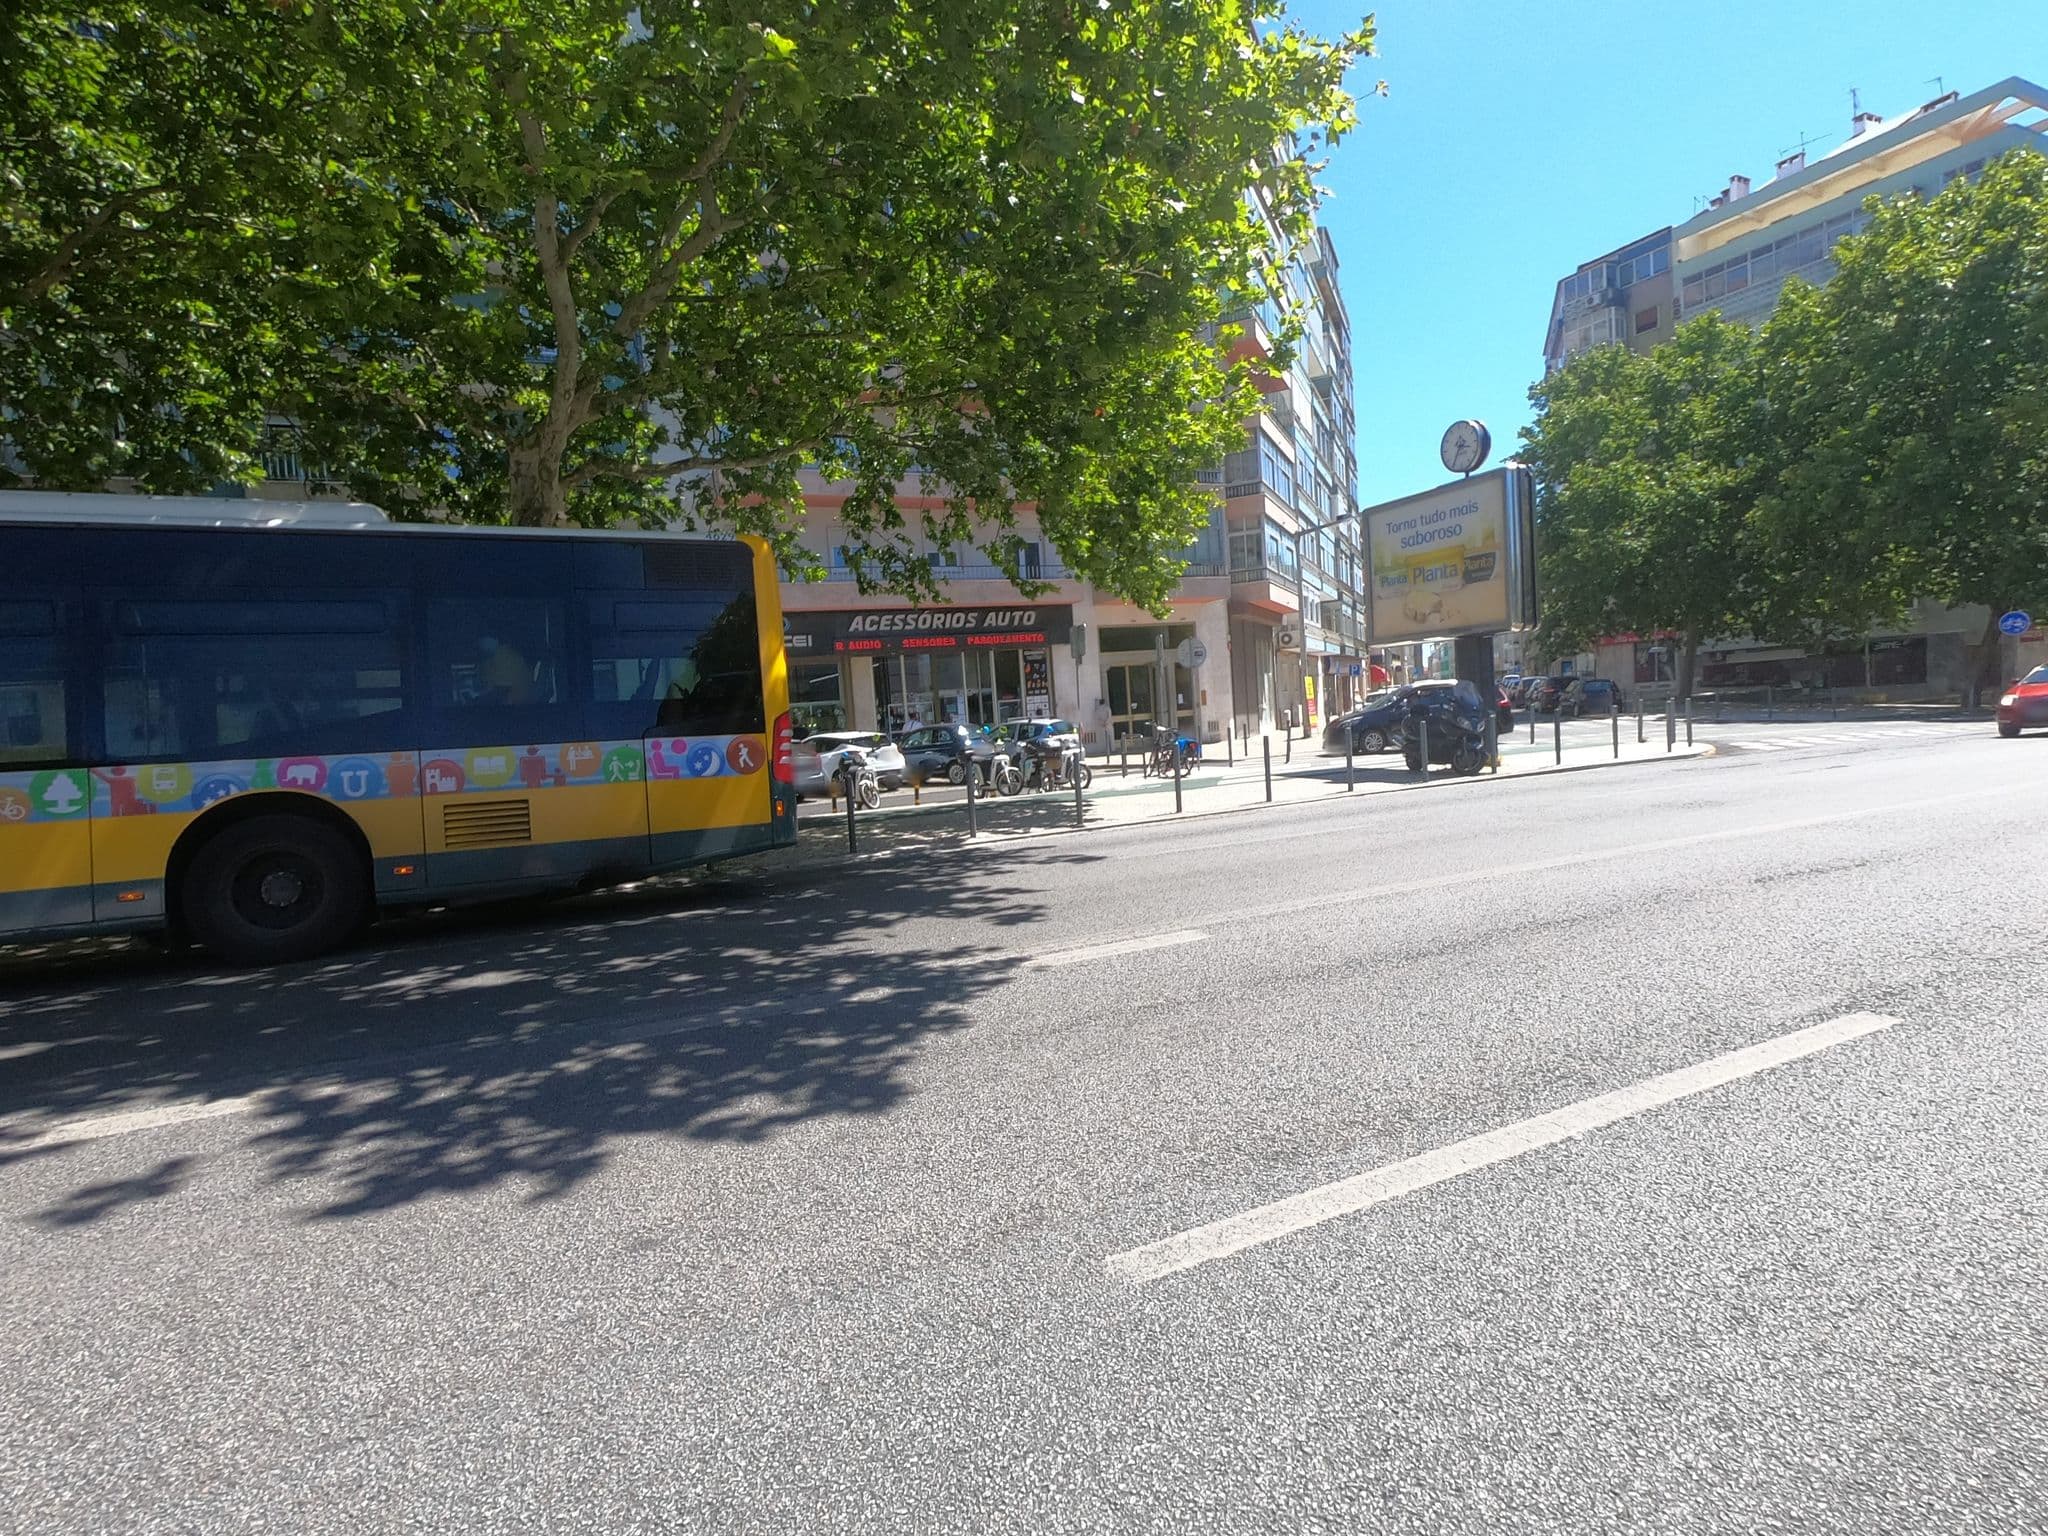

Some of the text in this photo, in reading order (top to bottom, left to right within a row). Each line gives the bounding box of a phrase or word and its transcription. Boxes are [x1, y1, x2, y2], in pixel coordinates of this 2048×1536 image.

[1386, 501, 1480, 535] Torna tudo mais
[1400, 524, 1462, 549] saboroso
[1413, 563, 1458, 585] Planta
[848, 609, 1036, 632] ACESSÓRIOS AUTO
[848, 639, 881, 650] AUDIO
